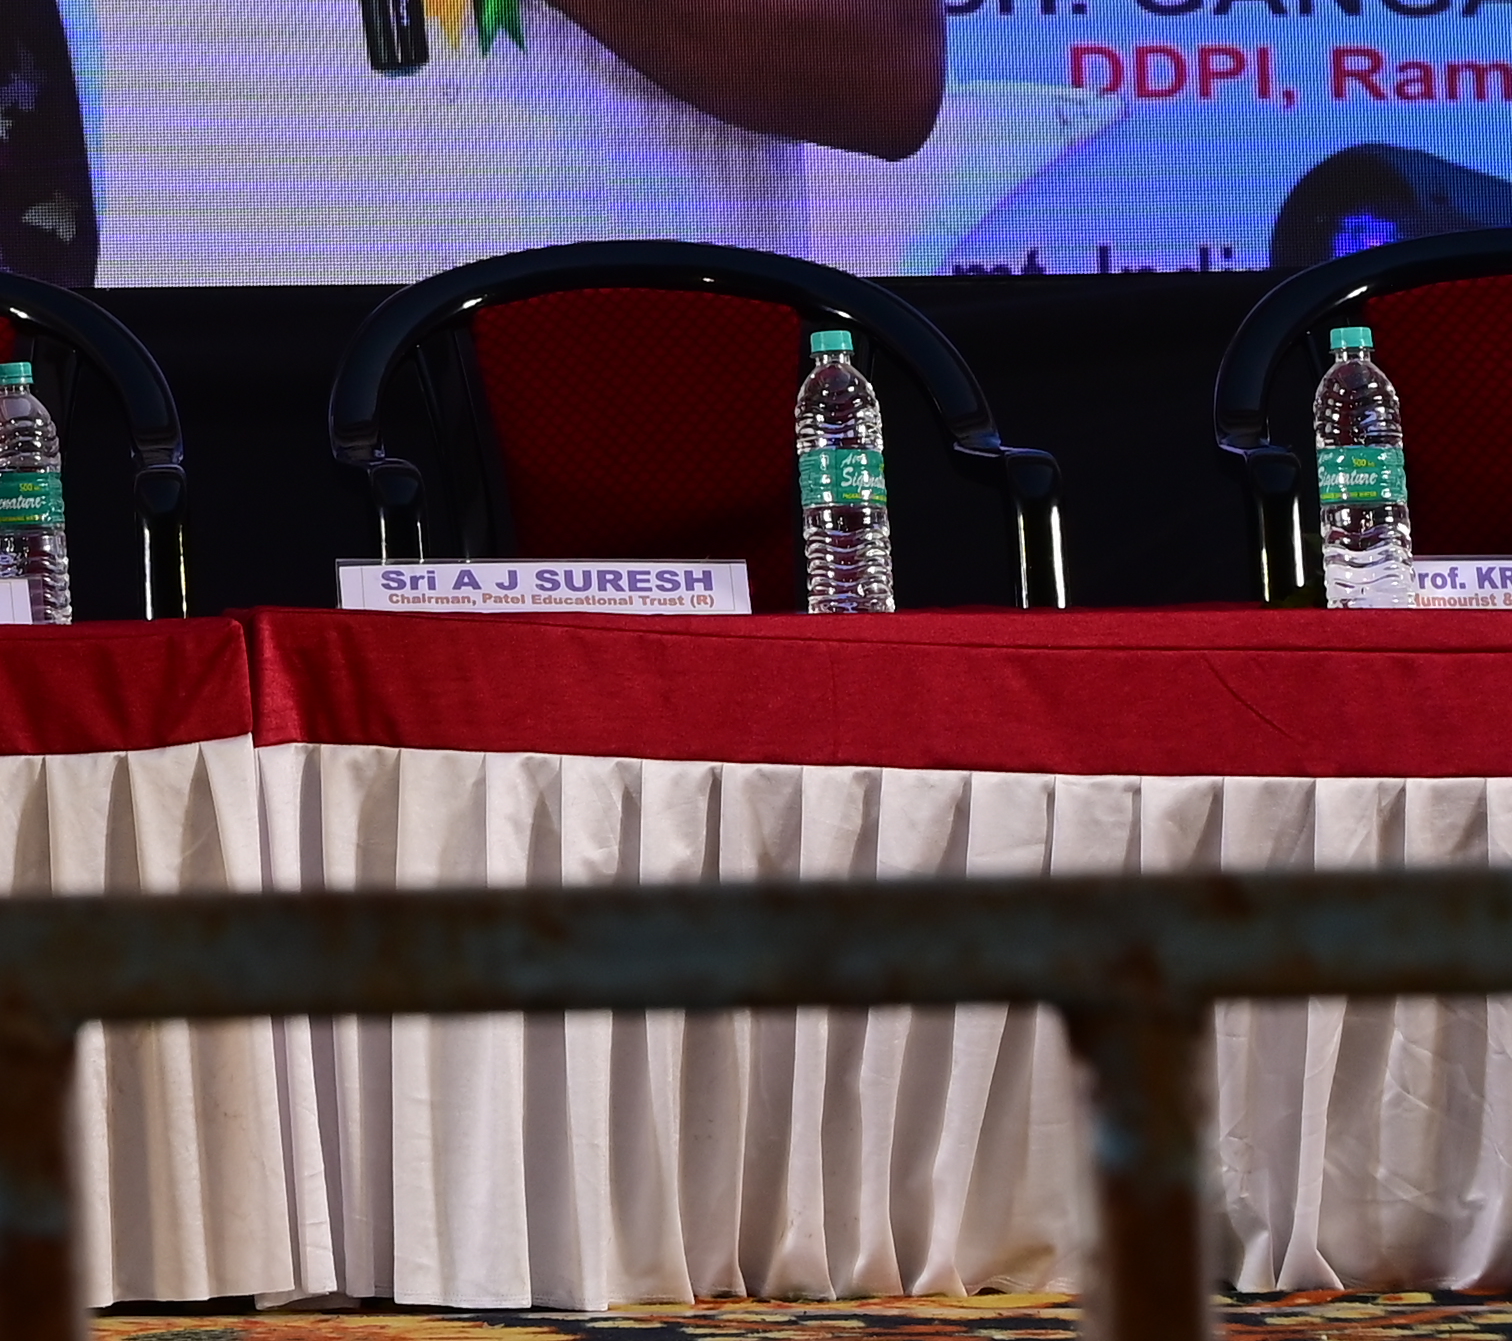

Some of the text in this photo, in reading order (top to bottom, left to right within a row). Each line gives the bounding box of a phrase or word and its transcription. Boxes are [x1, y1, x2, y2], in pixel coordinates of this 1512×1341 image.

[1070, 44, 1298, 109] DDPI,
[380, 568, 715, 594] Sri A J SURESH
[1414, 566, 1466, 590] rof.
[388, 592, 715, 609] Chairman, Patel Educational Trust (R)
